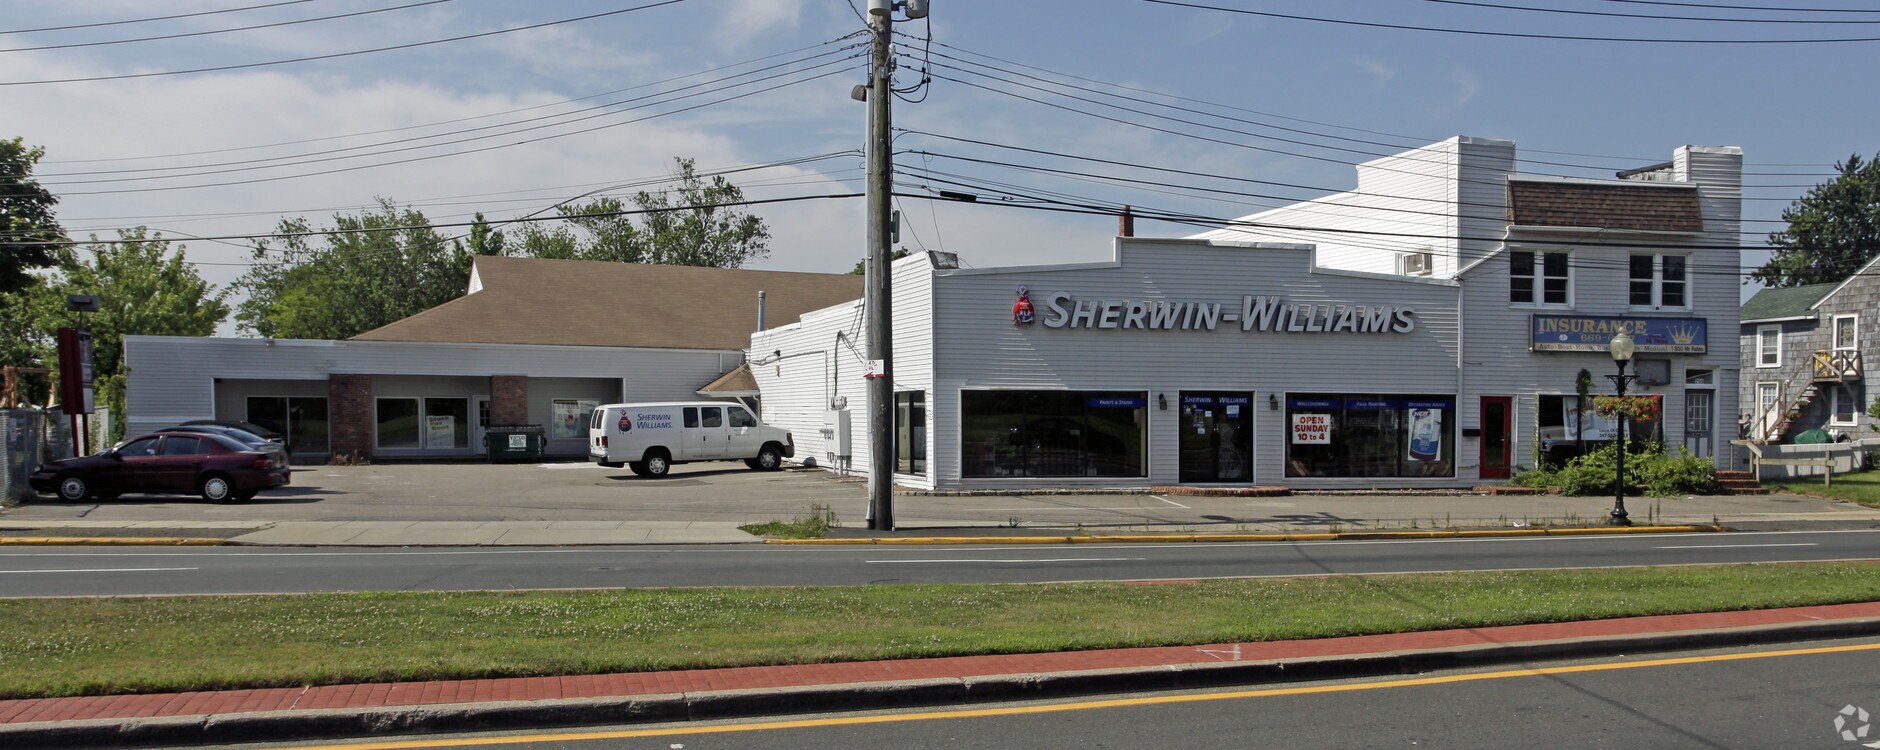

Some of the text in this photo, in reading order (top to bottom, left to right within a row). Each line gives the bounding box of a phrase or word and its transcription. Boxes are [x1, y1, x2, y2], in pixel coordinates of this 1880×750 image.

[1043, 291, 1416, 334] SHERWIN-WILLIAMS
[1538, 318, 1648, 335] INSURANCE
[1219, 396, 1248, 404] WILLIAMS
[637, 413, 671, 421] SHERWIN
[1299, 416, 1324, 424] OPEN
[637, 421, 672, 429] WILLIAMS
[1294, 425, 1329, 433] SUNDAY
[1297, 433, 1308, 441] 10
[1318, 433, 1325, 441] 4
